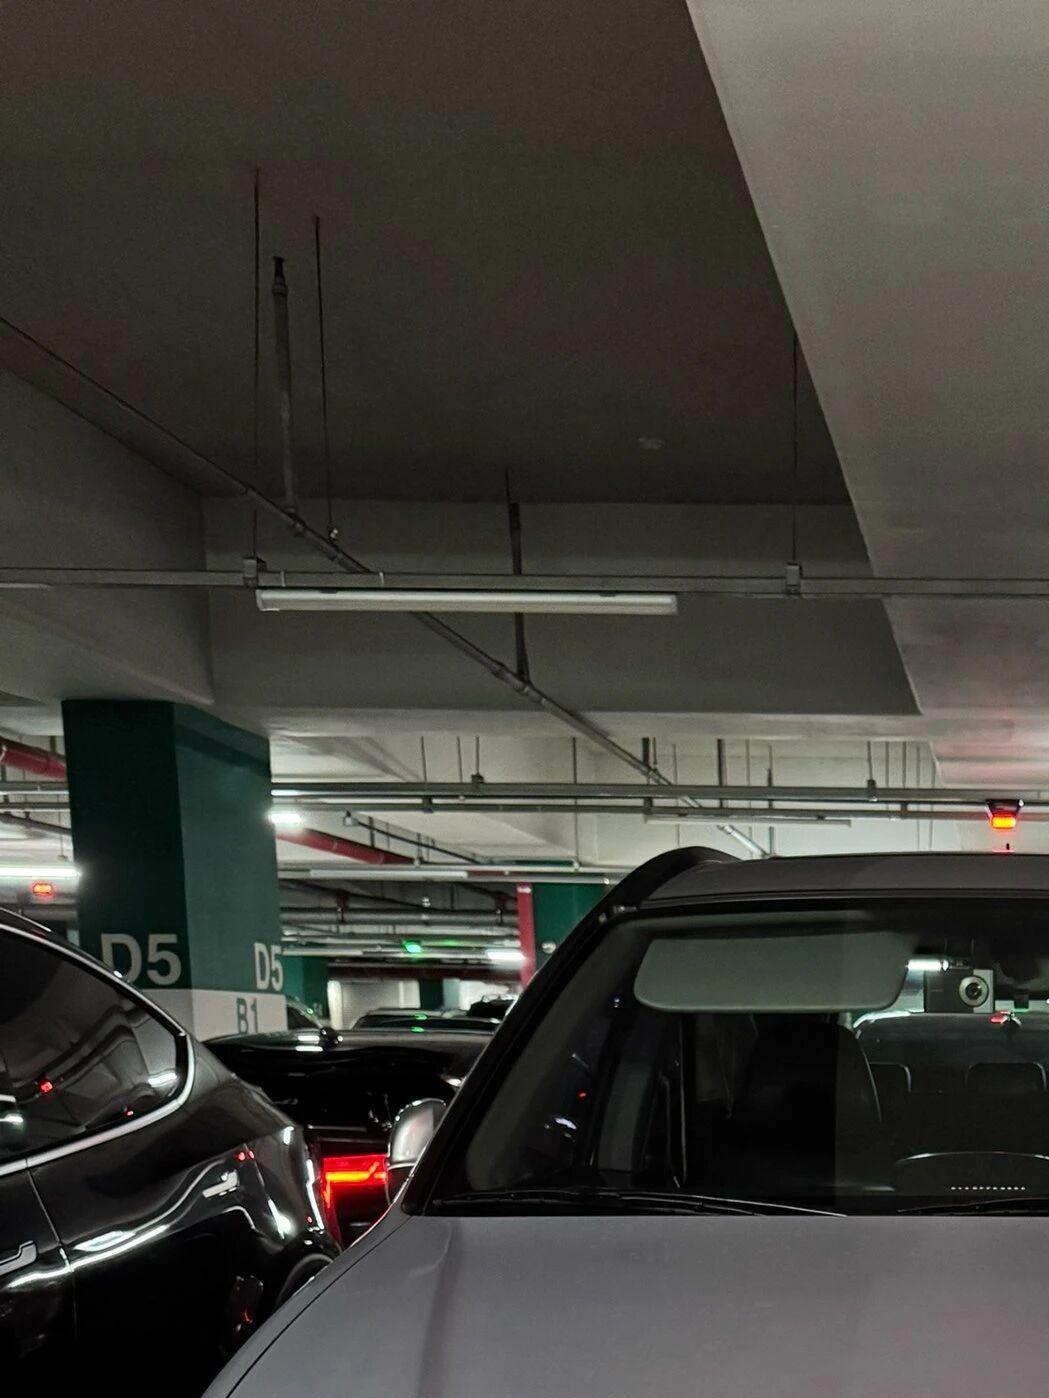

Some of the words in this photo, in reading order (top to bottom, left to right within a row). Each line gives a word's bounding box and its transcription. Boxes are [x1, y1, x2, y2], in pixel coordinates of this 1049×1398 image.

[101, 933, 182, 986] D5
[254, 942, 284, 991] D5
[236, 998, 258, 1033] B1
